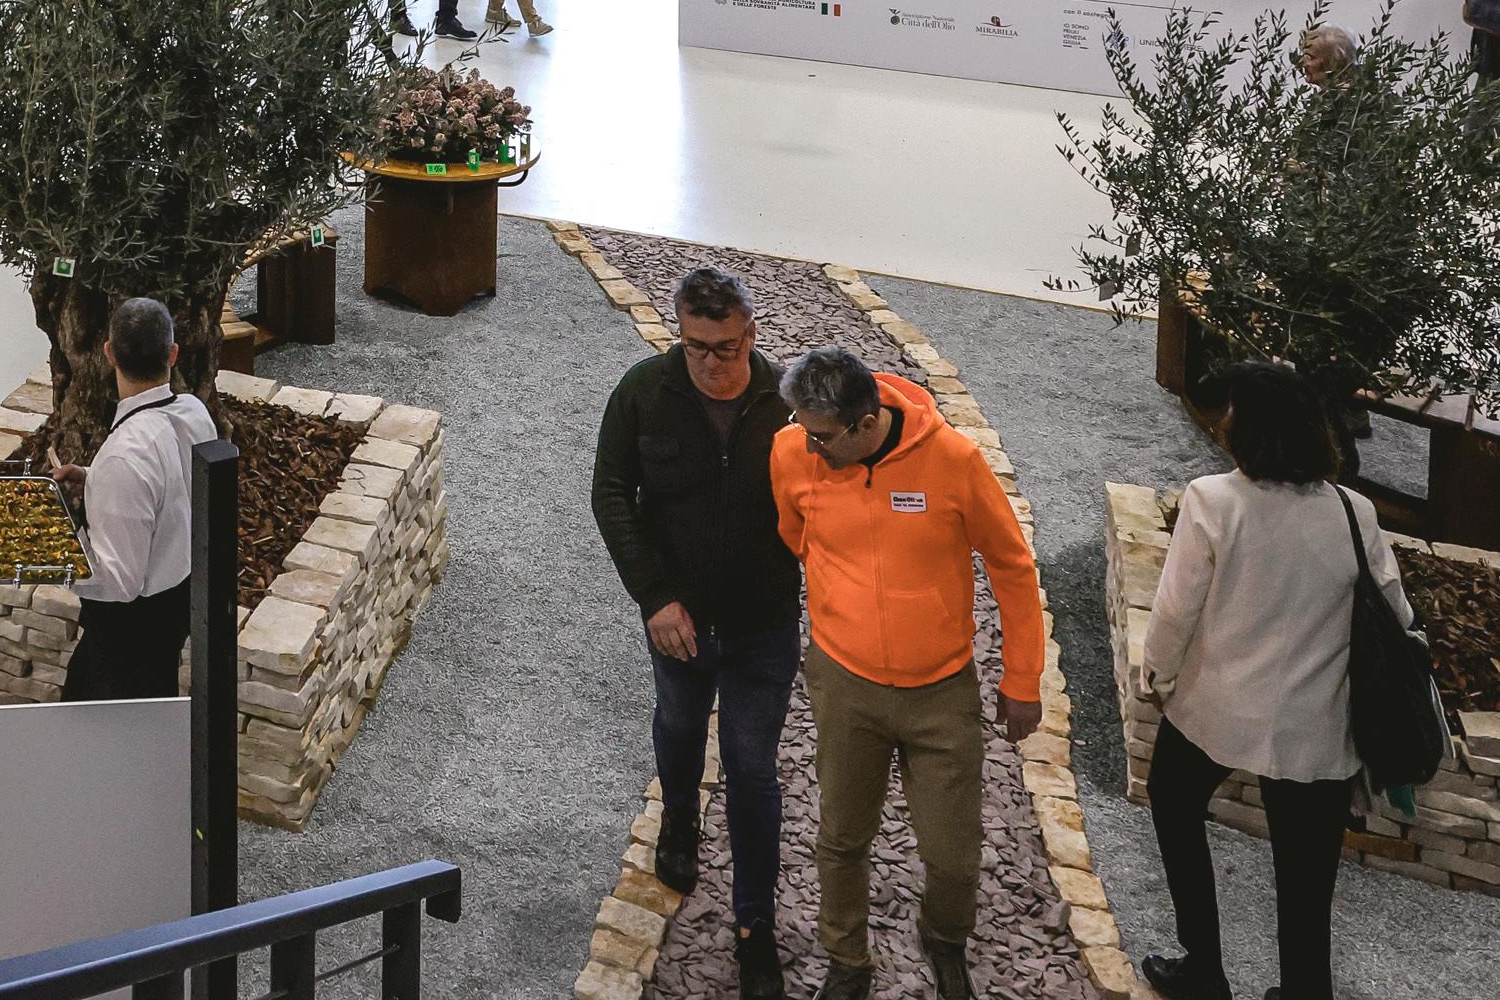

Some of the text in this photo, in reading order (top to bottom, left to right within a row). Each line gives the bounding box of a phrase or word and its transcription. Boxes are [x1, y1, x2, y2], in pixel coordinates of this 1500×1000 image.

[781, 2, 816, 10] ALIMENTARE
[901, 17, 956, 31] Città dell'Olio
[975, 26, 1018, 37] MIRABILIA
